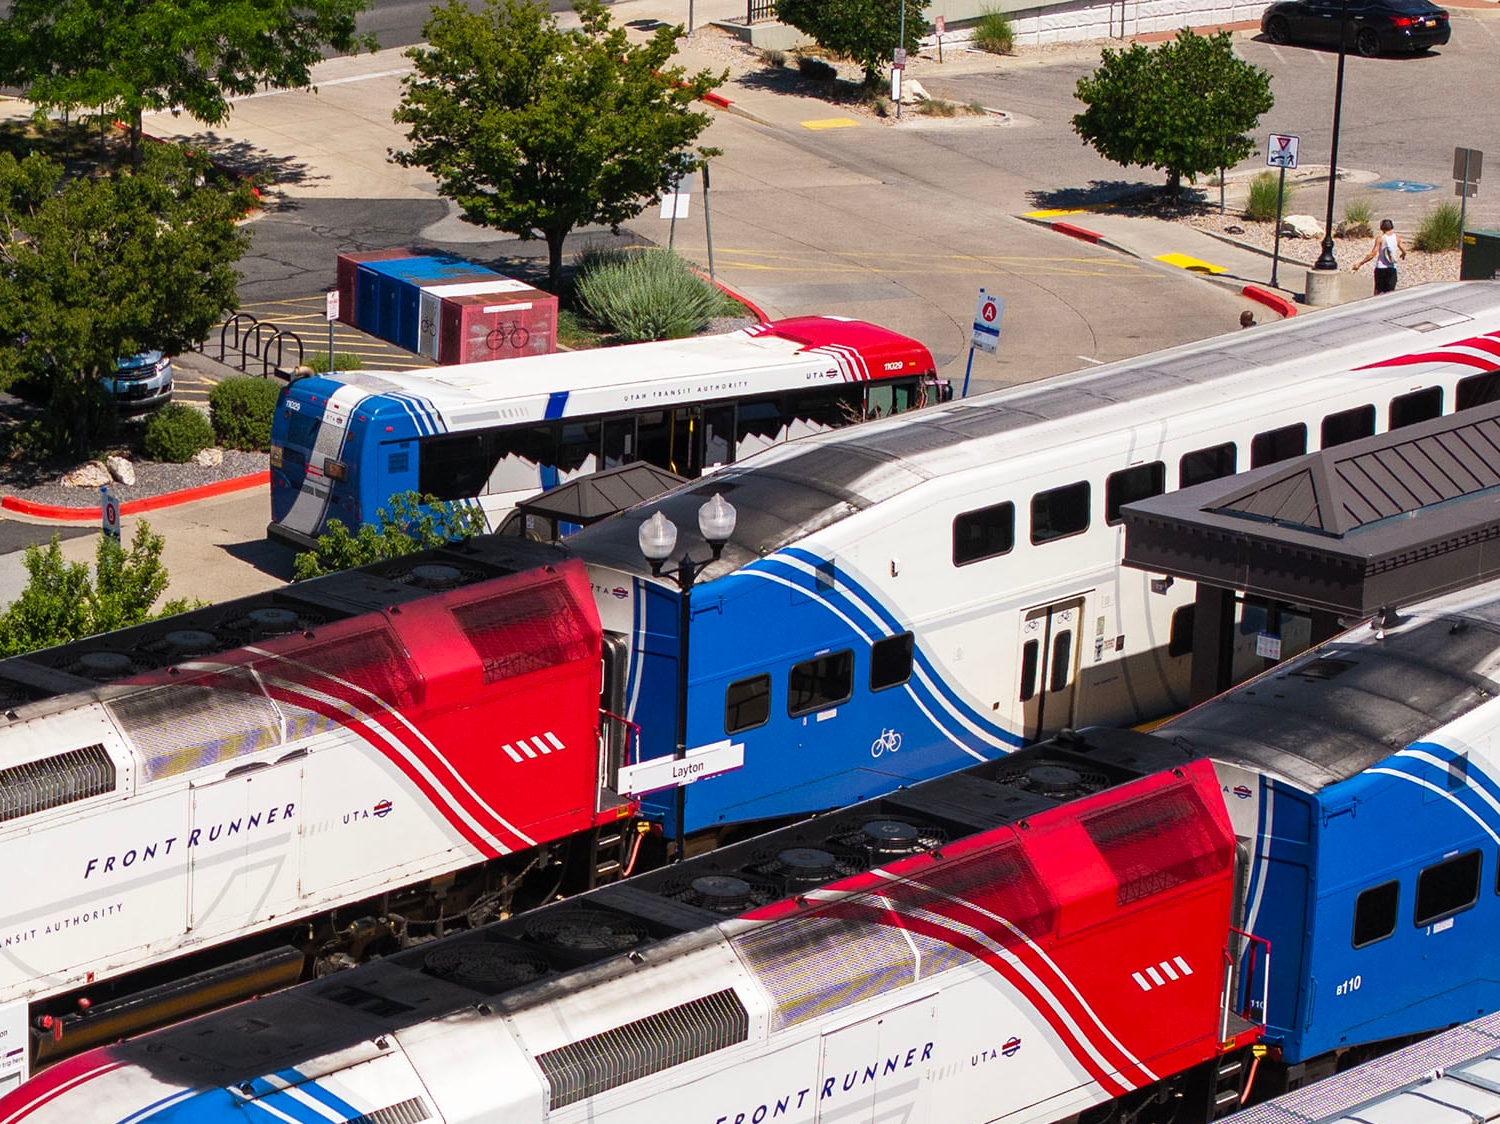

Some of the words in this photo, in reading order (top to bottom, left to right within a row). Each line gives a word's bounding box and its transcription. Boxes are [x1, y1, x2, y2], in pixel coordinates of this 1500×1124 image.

[984, 306, 994, 320] A
[884, 361, 904, 371] 11029
[806, 372, 824, 380] UTA
[653, 388, 691, 398] TRANSIT
[697, 381, 748, 393] AUTHORITY
[672, 762, 705, 778] Layton
[343, 809, 369, 824] UTA
[45, 903, 123, 934] AUTHORITY
[1336, 975, 1362, 996] B110
[971, 1048, 997, 1067] UTA
